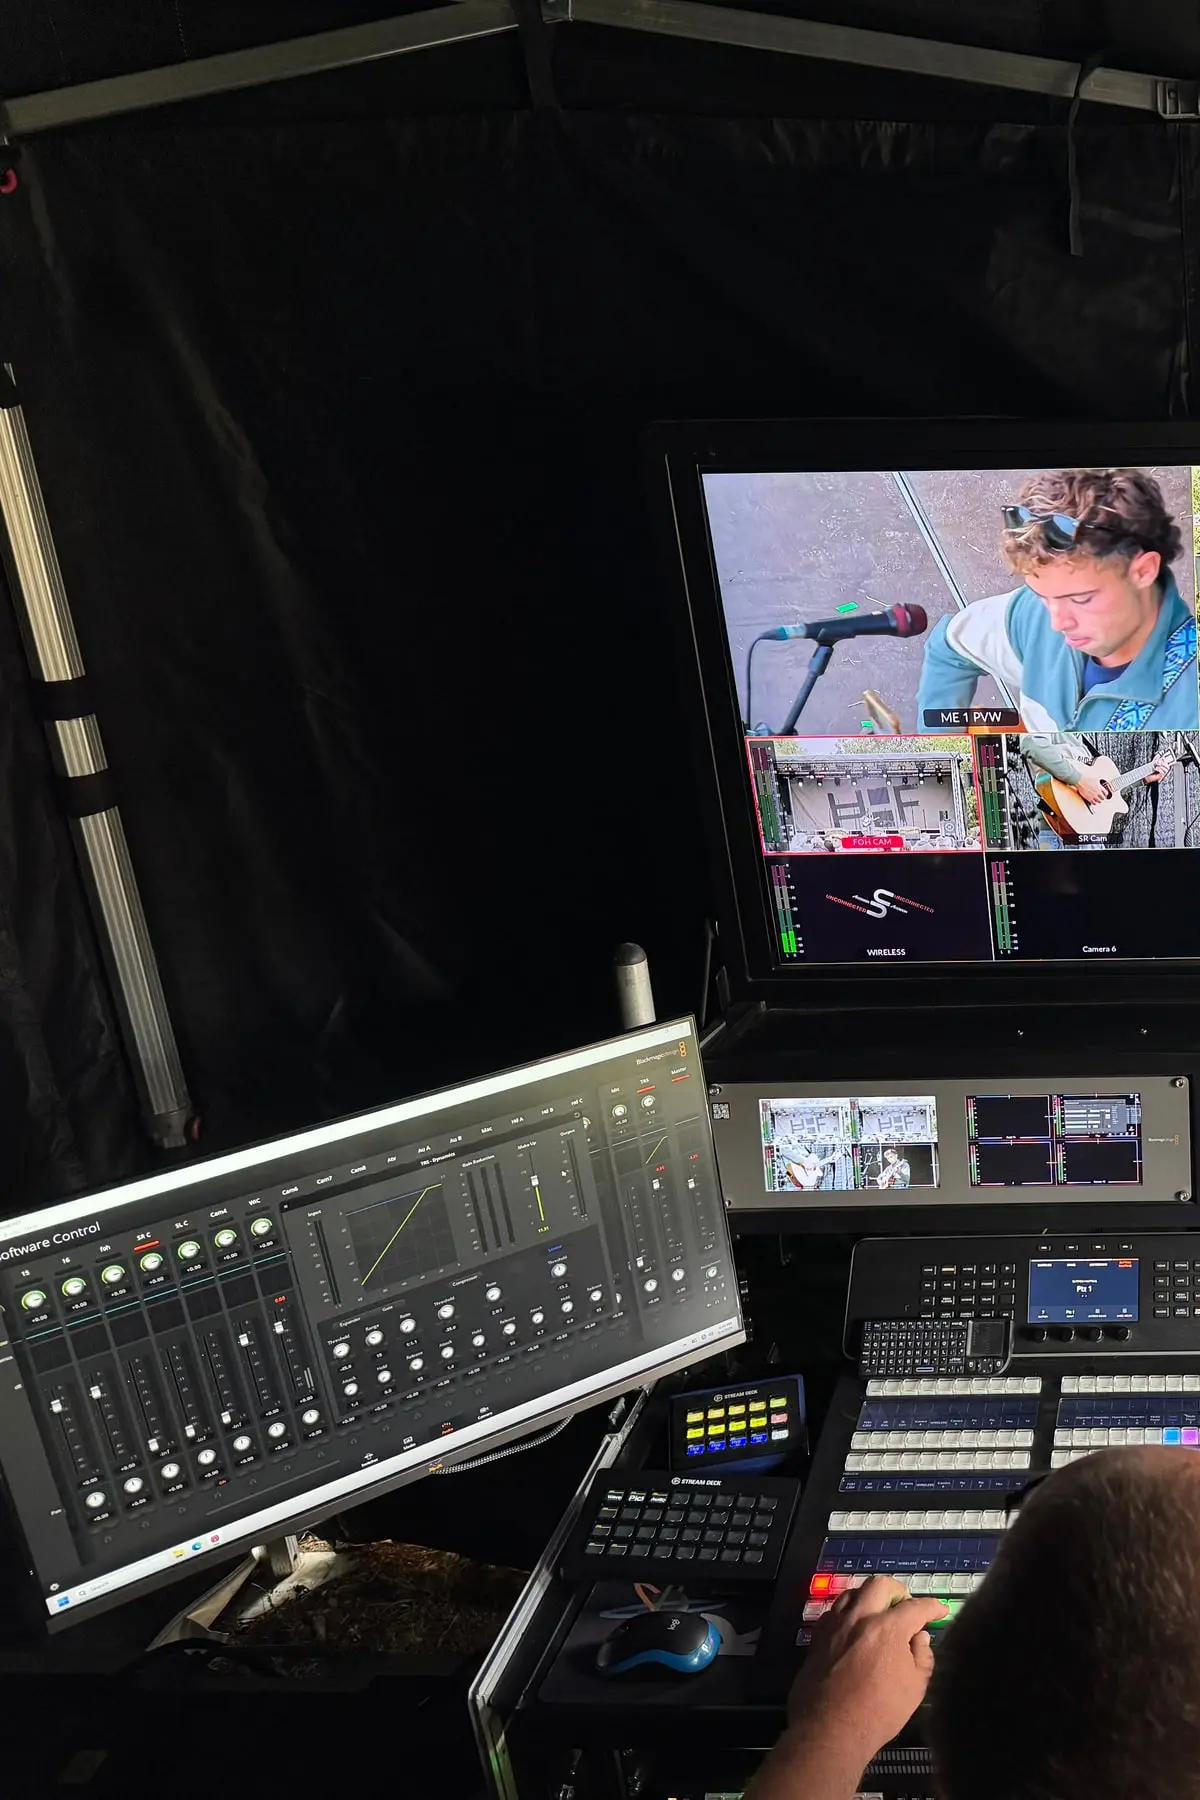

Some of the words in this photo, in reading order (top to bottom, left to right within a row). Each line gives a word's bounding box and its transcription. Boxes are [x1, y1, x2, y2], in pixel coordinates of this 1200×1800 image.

[940, 711, 960, 723] ME
[963, 711, 969, 723] 1
[974, 711, 1002, 723] PVW
[853, 838, 872, 846] FOH
[873, 837, 892, 846] CAM
[1090, 834, 1107, 842] Cam
[825, 893, 868, 914] UNCONNECTED
[867, 948, 906, 957] WIRELESS
[1082, 945, 1110, 953] Camera
[1111, 945, 1117, 953] 6
[671, 1066, 687, 1075] Master
[432, 1151, 456, 1164] Dynamics
[316, 1175, 332, 1185] Cam7
[282, 1186, 298, 1196] Cam6
[210, 1207, 228, 1218] Cam4
[0, 1237, 50, 1262] oftware
[52, 1221, 101, 1245] Control
[99, 1244, 111, 1253] foh
[1076, 1285, 1087, 1293] Ptz
[433, 1296, 455, 1307] Threshold
[327, 1333, 350, 1346] Threshold
[724, 1391, 745, 1400] STREAM
[745, 1389, 758, 1398] DECK
[681, 1478, 705, 1486] STREAM
[706, 1479, 723, 1487] DECK
[667, 1618, 681, 1631] logi
